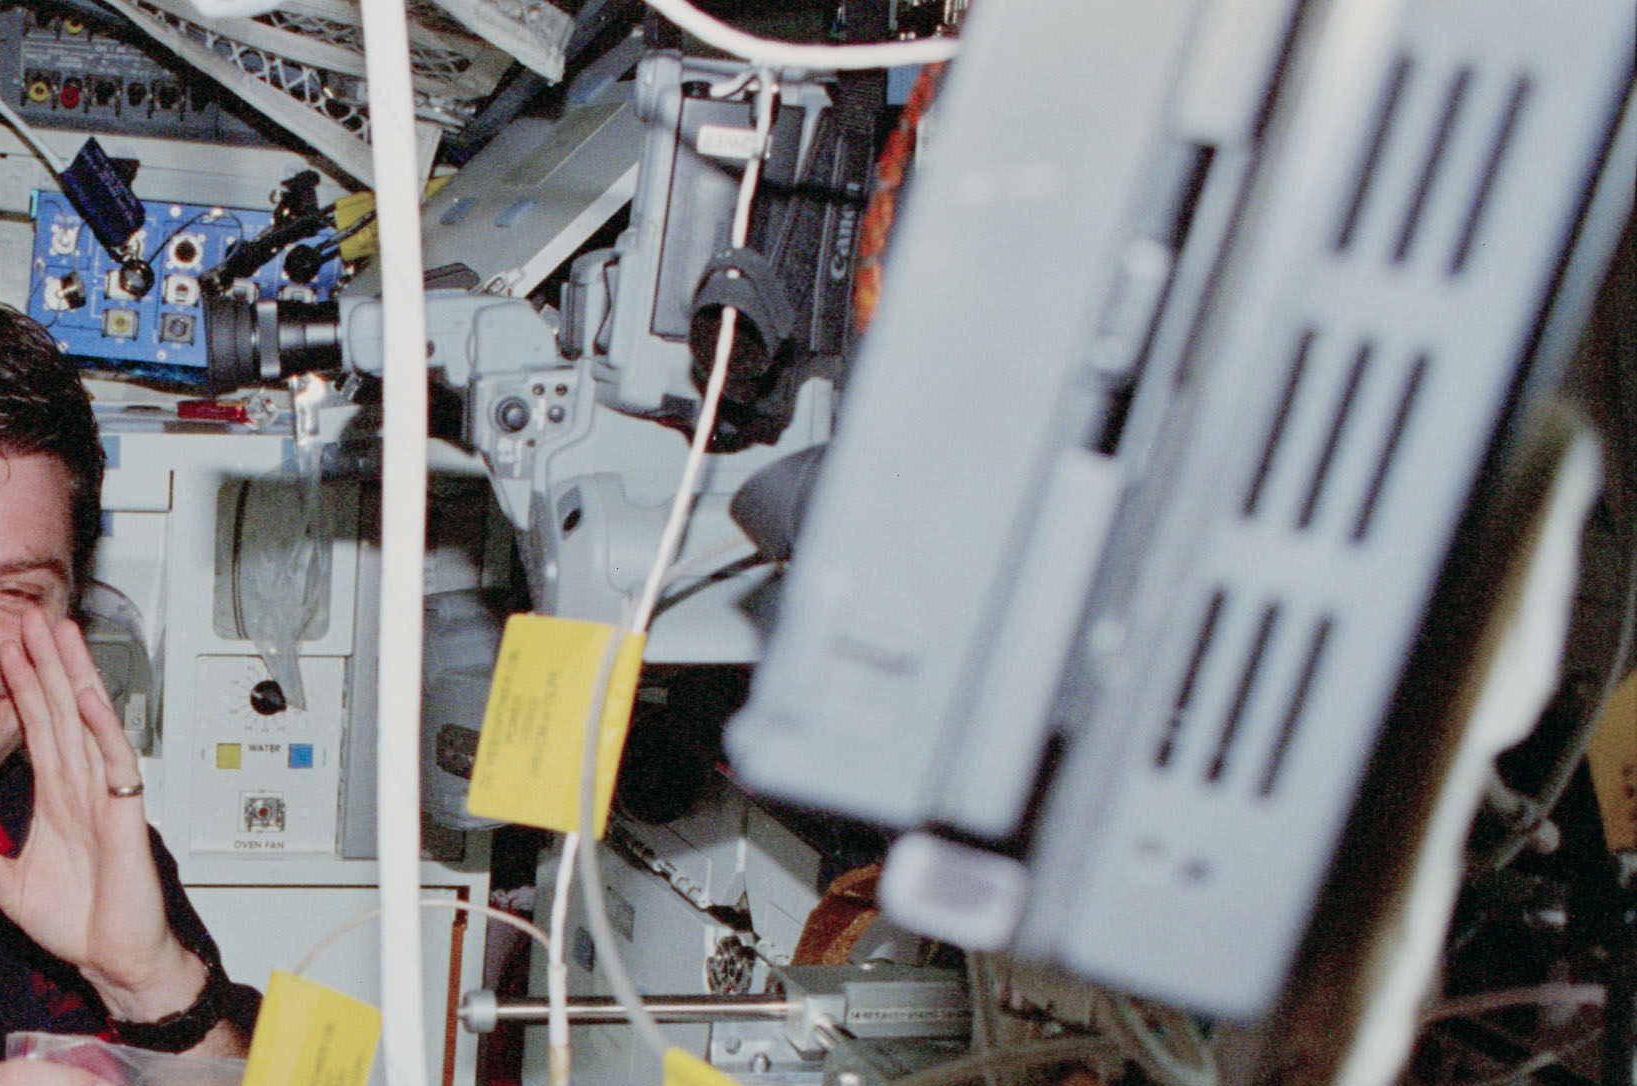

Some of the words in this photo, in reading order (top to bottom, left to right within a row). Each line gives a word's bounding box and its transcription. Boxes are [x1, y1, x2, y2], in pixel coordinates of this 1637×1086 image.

[247, 743, 282, 753] WATER
[233, 839, 262, 850] OVEN
[264, 839, 285, 850] FAN
